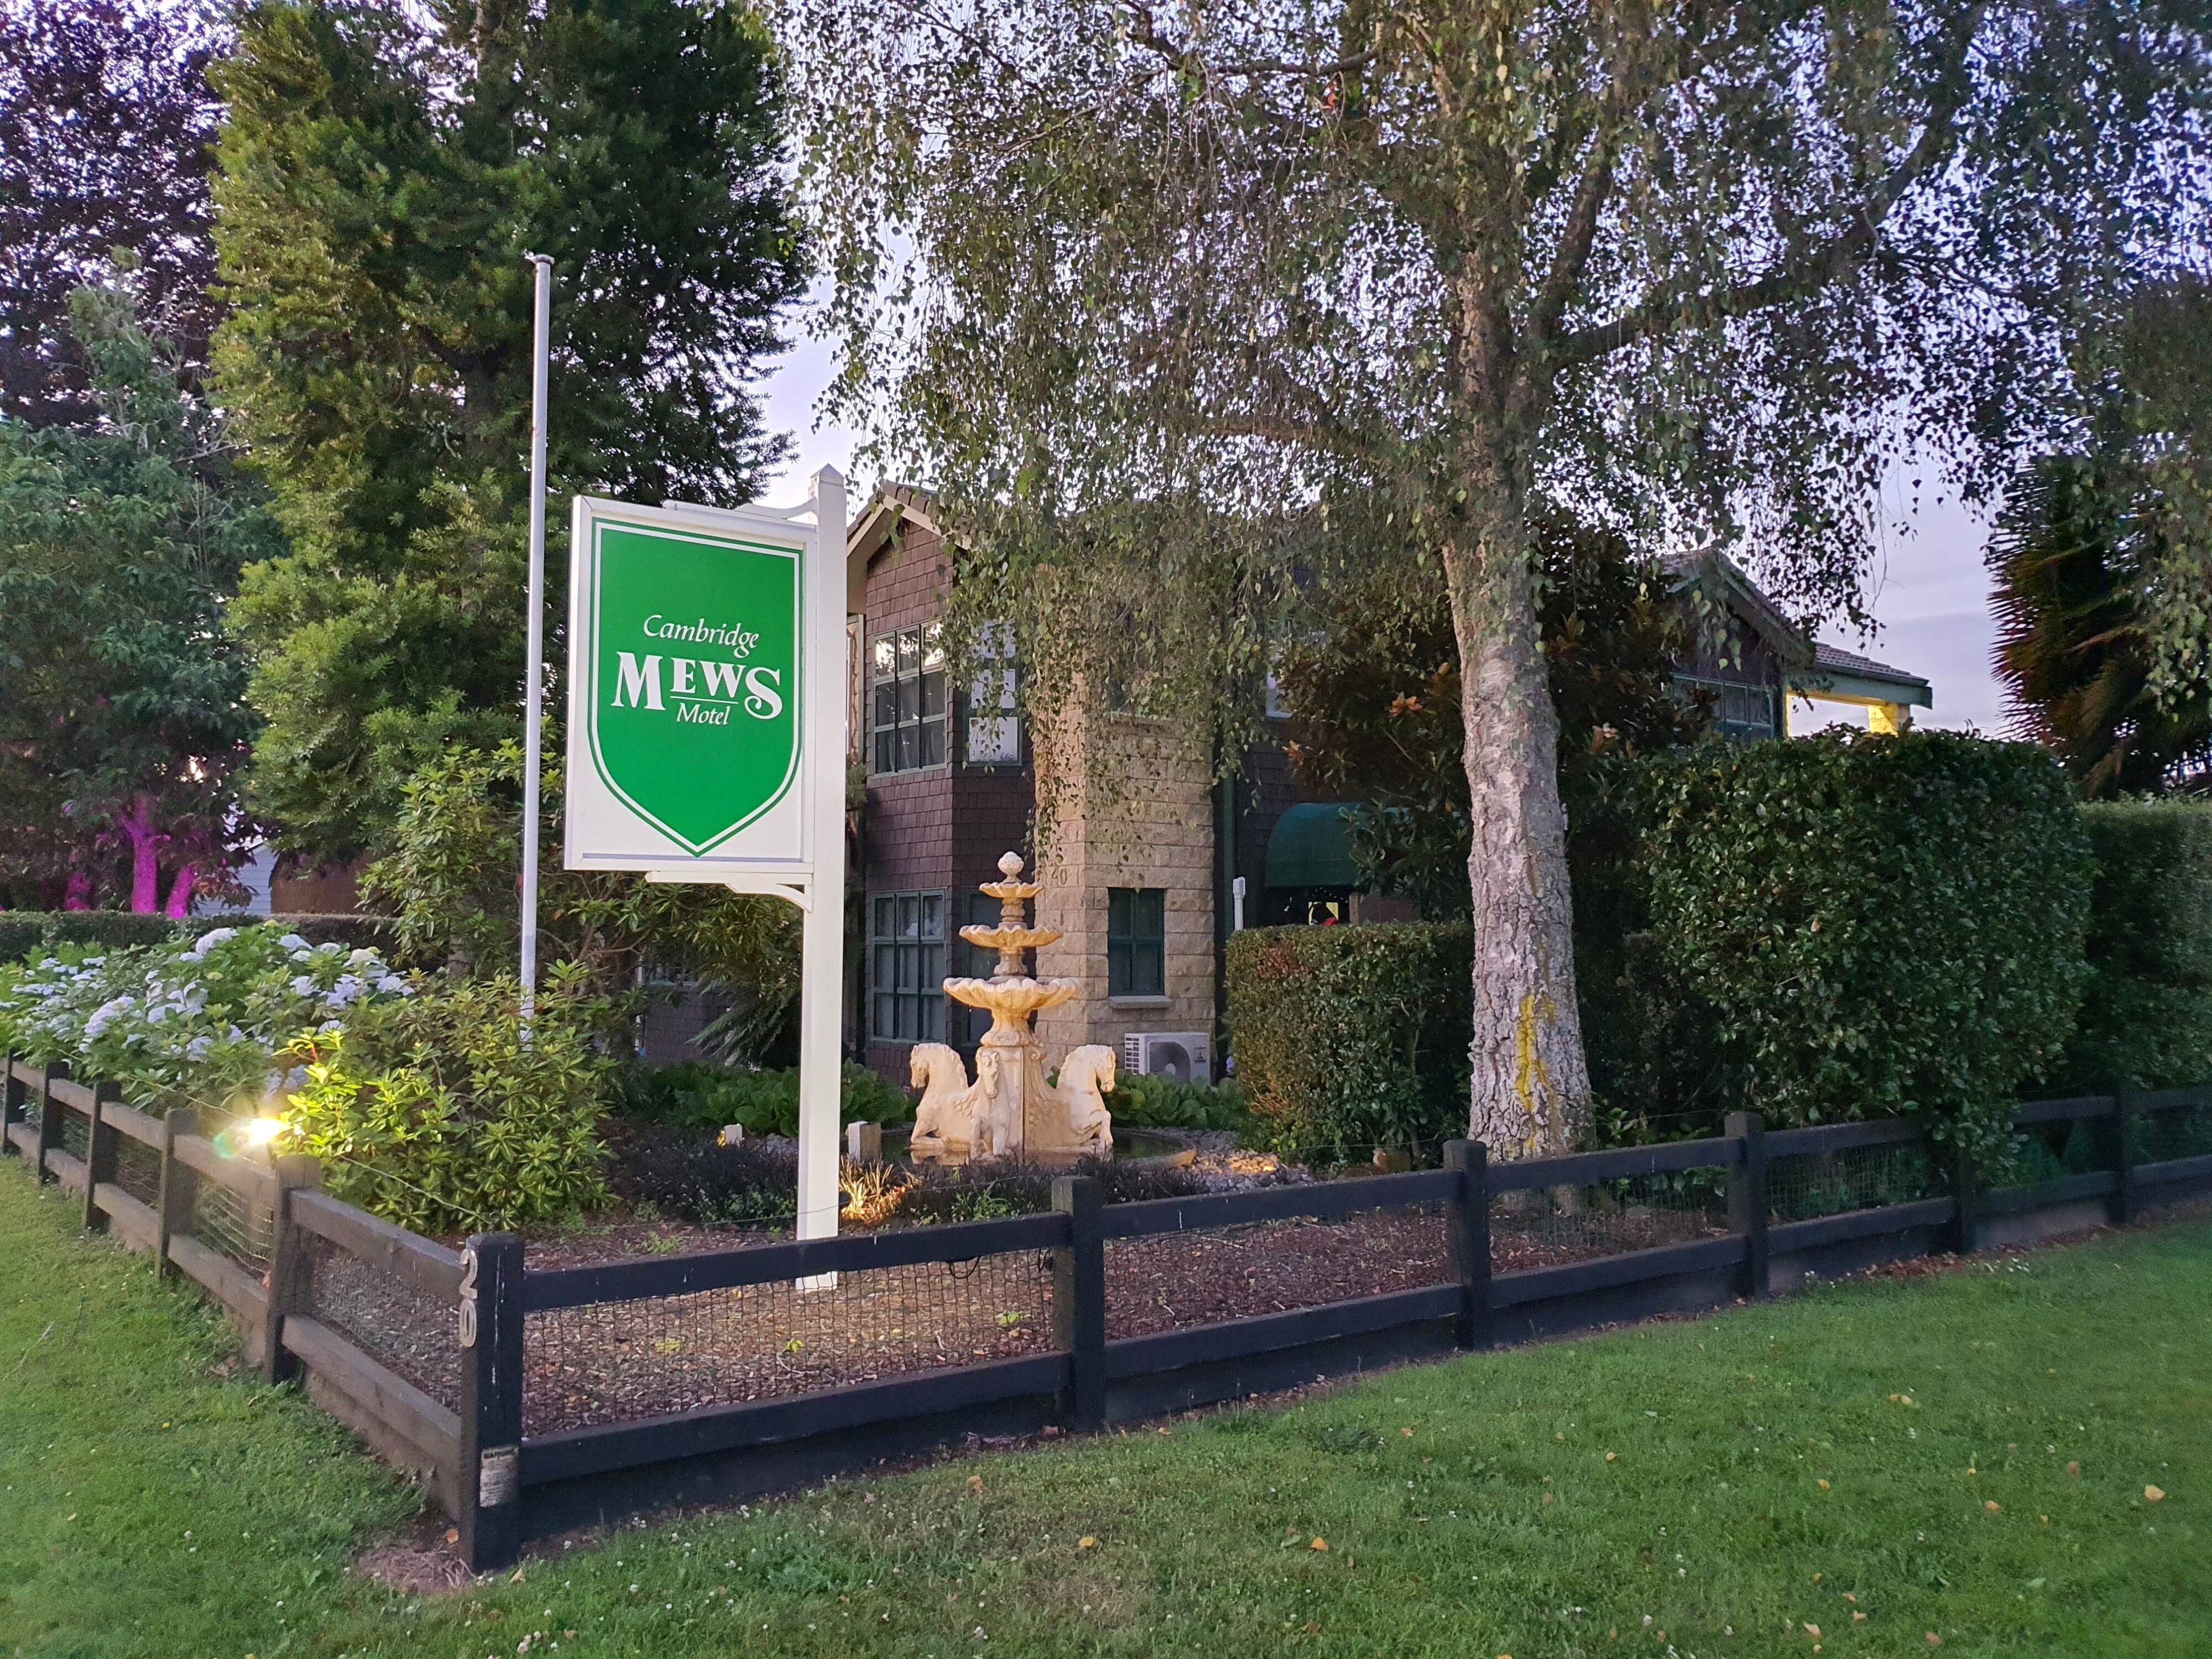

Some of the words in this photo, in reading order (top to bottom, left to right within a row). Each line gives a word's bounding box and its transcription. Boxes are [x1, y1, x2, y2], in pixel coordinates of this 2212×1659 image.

[644, 614, 759, 658] Cambridge
[611, 651, 782, 719] MEWS
[676, 702, 730, 725] Motel
[460, 1249, 478, 1347] 20
